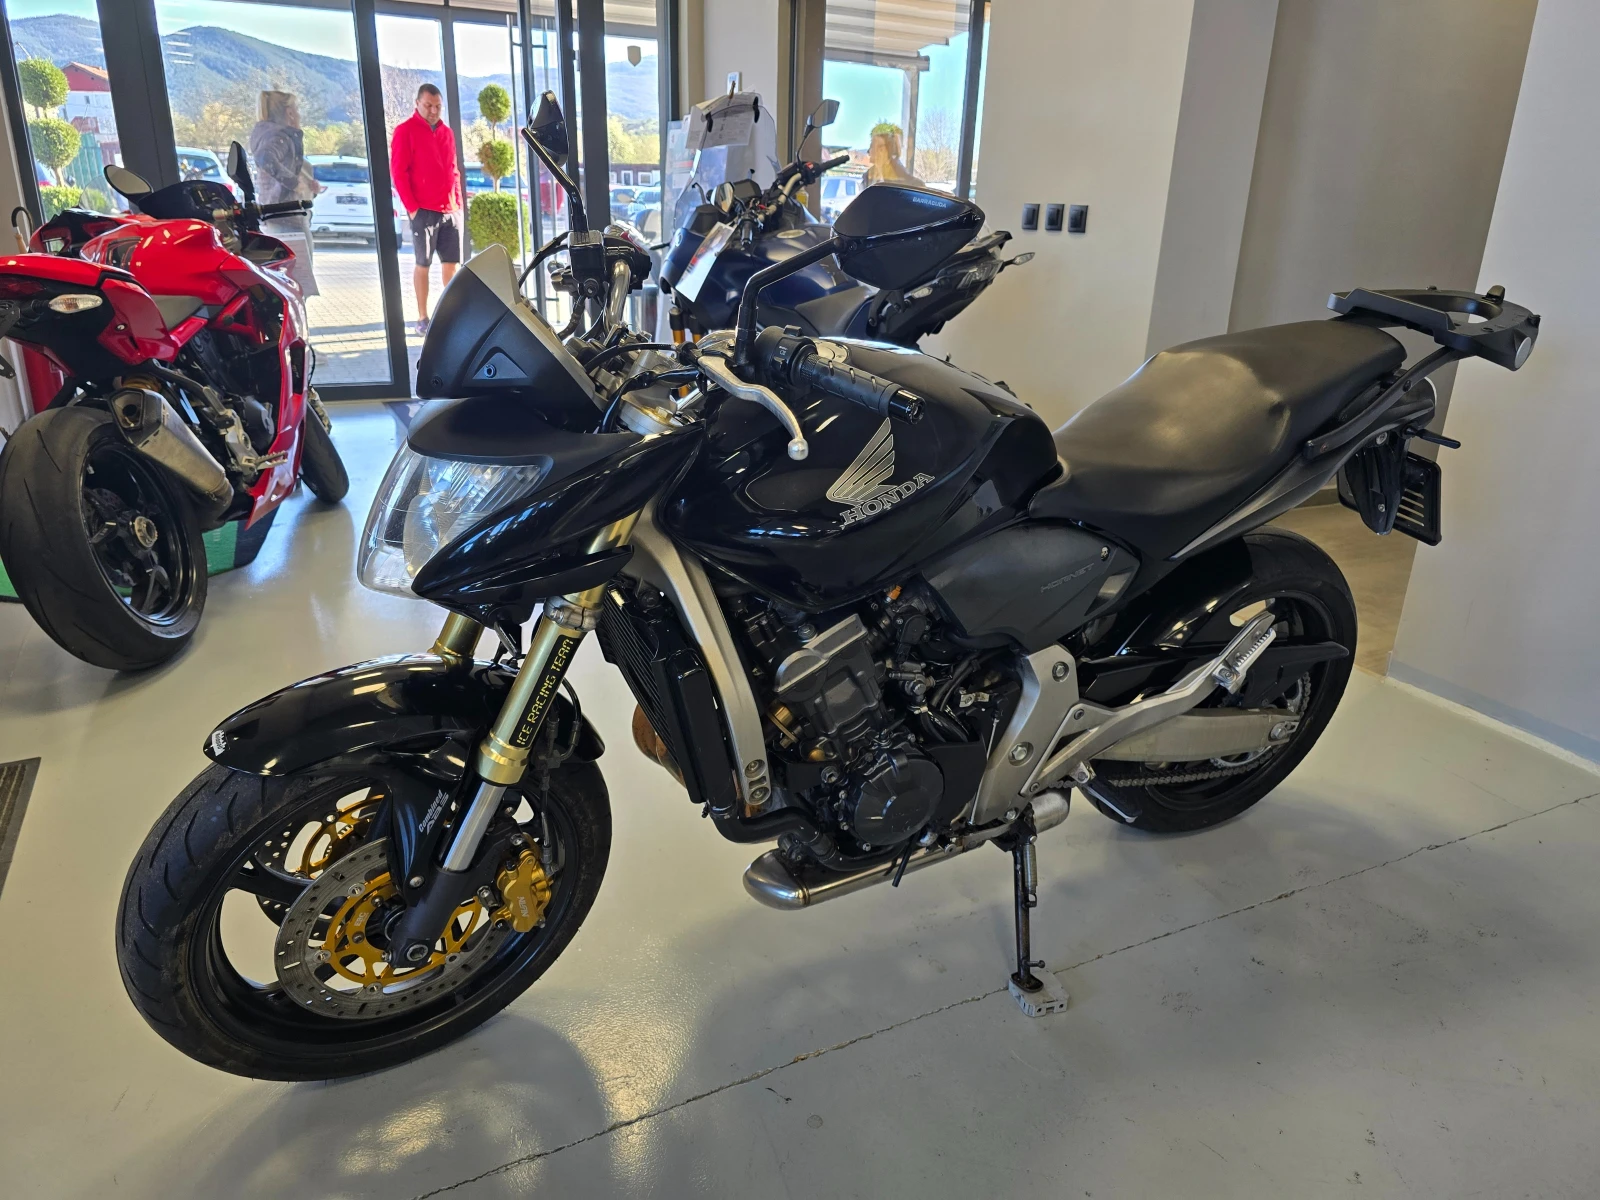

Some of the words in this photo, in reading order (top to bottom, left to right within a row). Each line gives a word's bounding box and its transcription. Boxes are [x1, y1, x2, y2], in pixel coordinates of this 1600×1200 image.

[912, 196, 947, 208] BARRACUDA
[839, 472, 936, 527] HONDA
[1041, 562, 1095, 593] HORNET
[516, 724, 533, 745] ICE
[527, 674, 556, 723] RACING
[550, 638, 574, 672] TEAM
[418, 789, 443, 833] Combined
